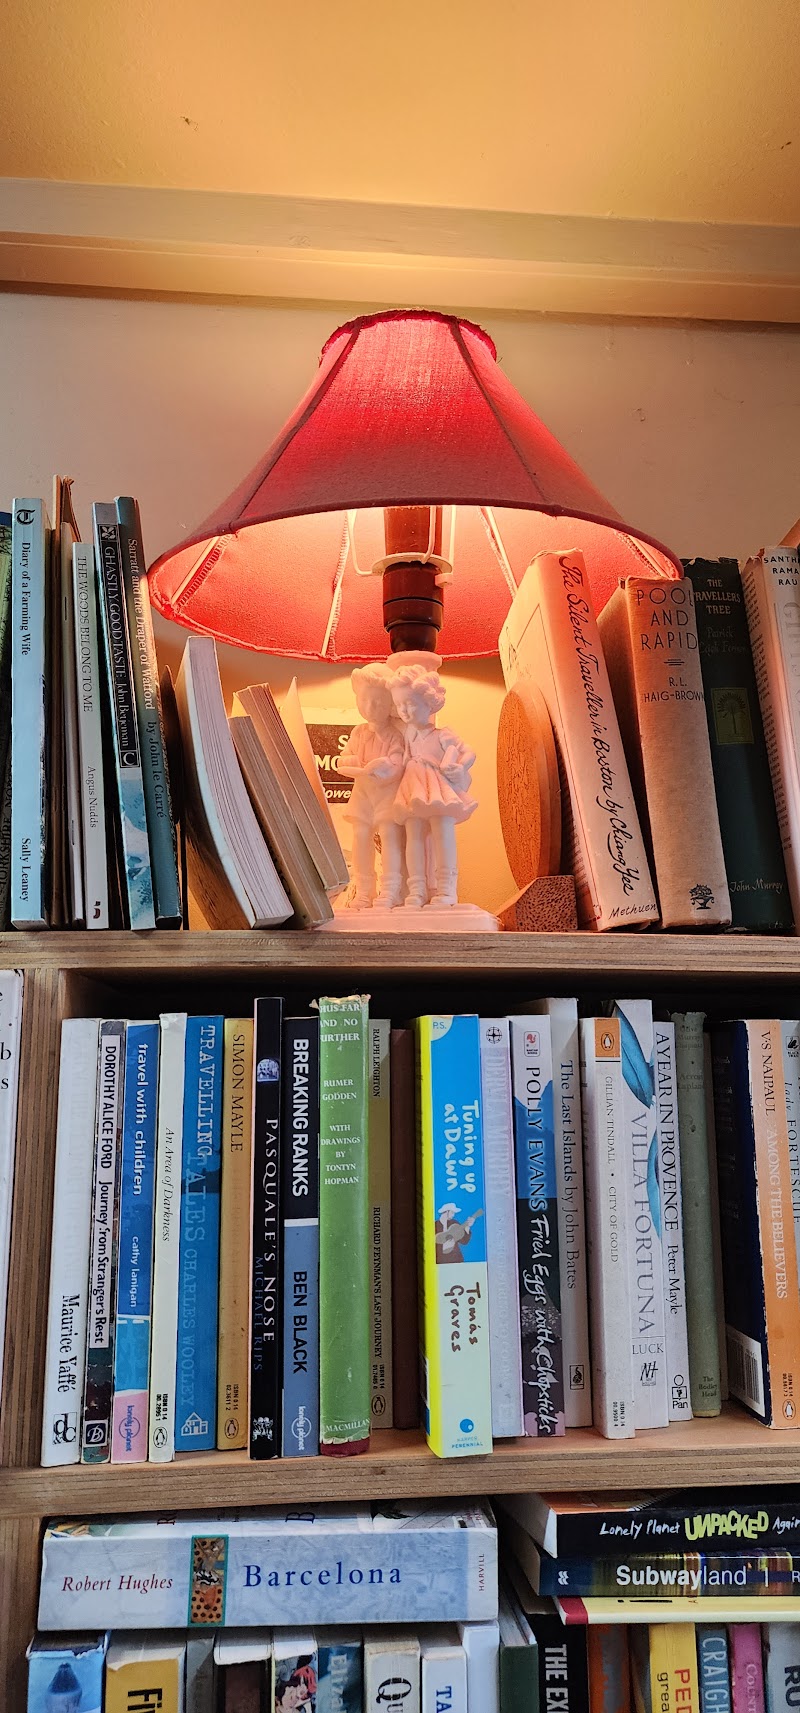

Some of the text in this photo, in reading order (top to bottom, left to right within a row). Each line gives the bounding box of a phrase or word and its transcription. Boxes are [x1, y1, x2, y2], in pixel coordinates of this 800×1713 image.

[104, 547, 119, 601] GHASTLY
[706, 579, 723, 588] THE
[772, 567, 800, 576] RAMA
[20, 542, 31, 656] Diary of Farming Wife
[109, 602, 122, 640] GOOD
[650, 610, 689, 626] AND
[705, 605, 731, 615] TREE
[78, 557, 93, 712] THE WOODS BELONG TO ME
[112, 640, 127, 680] TASTE
[127, 540, 167, 819] Sarratt and the Draper of Watford by John le Carré
[559, 556, 640, 897] The Silent Traveller in Boston by Chiang Yee
[87, 766, 97, 828] Angus Nudds
[19, 838, 31, 902] Sally Leaney
[730, 881, 751, 893] John
[608, 903, 657, 920] Methuen
[342, 1002, 361, 1013] FAR
[344, 1017, 359, 1028] NO
[433, 1022, 447, 1030] P.S.
[103, 1046, 116, 1101] DOROTHY
[324, 1078, 354, 1088] RUMER
[372, 1029, 381, 1097] RALPH LEIGHTON
[761, 1055, 776, 1116] NAIPAUL
[197, 1025, 216, 1157] TRAVELLING
[230, 1034, 245, 1153] SIMON MAYLE
[291, 1038, 310, 1198] BREAKING RANKS
[322, 1091, 358, 1102] GODDEN
[525, 1067, 543, 1130] POLLY
[102, 1103, 115, 1135] ALICE
[133, 1044, 149, 1196] travel with children
[320, 1135, 361, 1146] DRAWINGS
[329, 1123, 351, 1132] WITH
[101, 1136, 114, 1169] FORD
[325, 1163, 357, 1173] TONTYN
[335, 1150, 346, 1158] BY
[444, 1103, 461, 1191] at Dawn
[459, 1100, 479, 1194] Tuning up
[605, 1076, 618, 1263] GILLIAN TINDALL CITY OF GOLD
[656, 1032, 682, 1315] A YEAR IN PROVENCE Peter Mayle
[161, 1127, 175, 1242] An Area of Darkness
[324, 1175, 360, 1186] HOPMAN
[528, 1140, 547, 1211] EVANS
[559, 1060, 580, 1290] The Last Islands by John Bates
[96, 1180, 112, 1229] Journey
[262, 1118, 279, 1342] PASQUALE'S NOSE
[631, 1112, 656, 1334] VILLA FORTUNA
[766, 1128, 788, 1299] AMONG THE BELIEVERS
[94, 1254, 109, 1314] Stranger's
[128, 1235, 139, 1308] cathy lanigan
[59, 1293, 80, 1352] Maurice
[94, 1316, 107, 1343] Rest
[293, 1270, 308, 1374] BEN BLACK
[374, 1295, 382, 1316] LAST
[444, 1284, 465, 1353] Graves
[465, 1281, 481, 1345] Tomás
[522, 1214, 559, 1435] Fried Eggs with Chopsticks
[375, 1318, 383, 1359] JOURNEY
[632, 1343, 664, 1355] LUCK
[297, 1405, 307, 1428] lonely
[672, 1401, 689, 1410] Pan
[599, 1510, 769, 1541] Lonely Planet UNPACKED
[61, 1573, 173, 1595] Robert Hughes
[243, 1562, 402, 1587] Barcelona
[616, 1564, 746, 1590] Subwayland
[545, 1644, 569, 1713] THE EX
